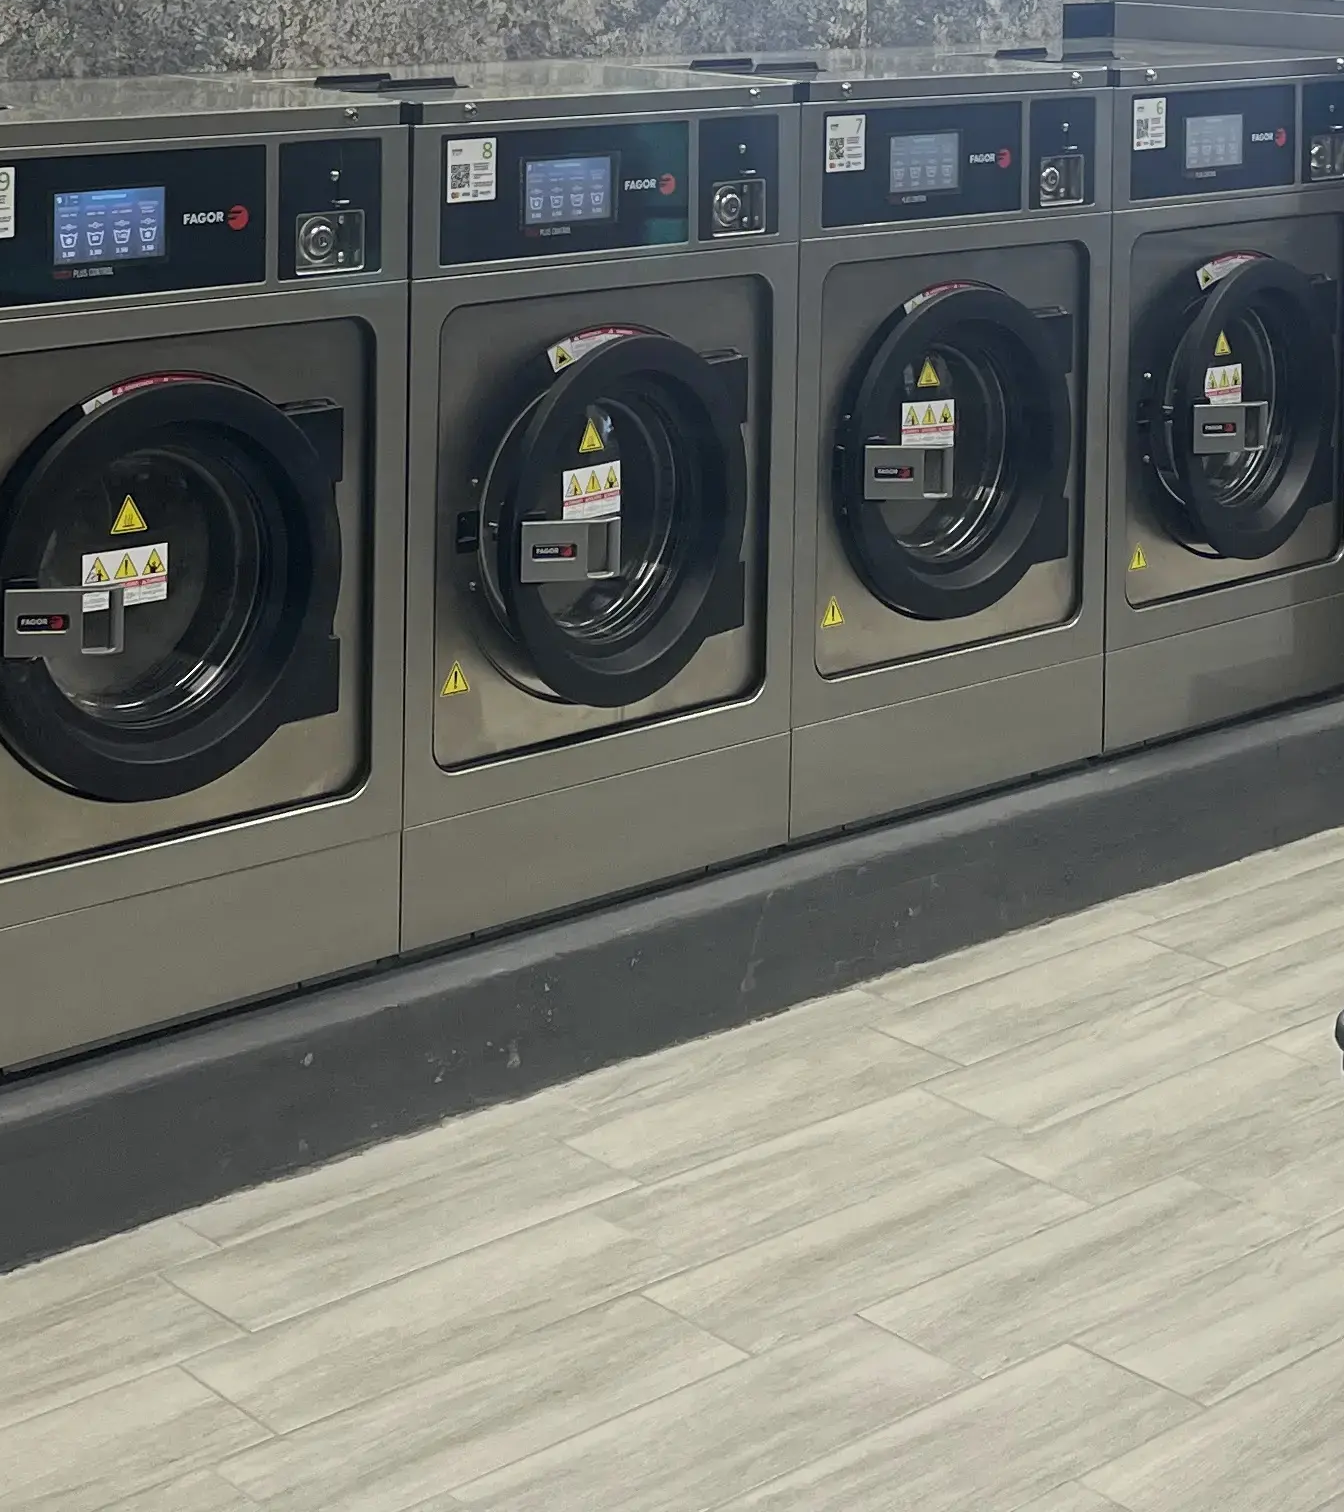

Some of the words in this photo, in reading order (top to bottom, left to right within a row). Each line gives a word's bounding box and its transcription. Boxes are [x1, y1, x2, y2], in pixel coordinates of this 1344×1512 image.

[1156, 100, 1164, 115] 6
[855, 118, 863, 134] 7
[483, 142, 493, 159] 8
[969, 152, 996, 164] FAGOR
[624, 178, 657, 191] FAGOR
[183, 210, 224, 225] FAGOR
